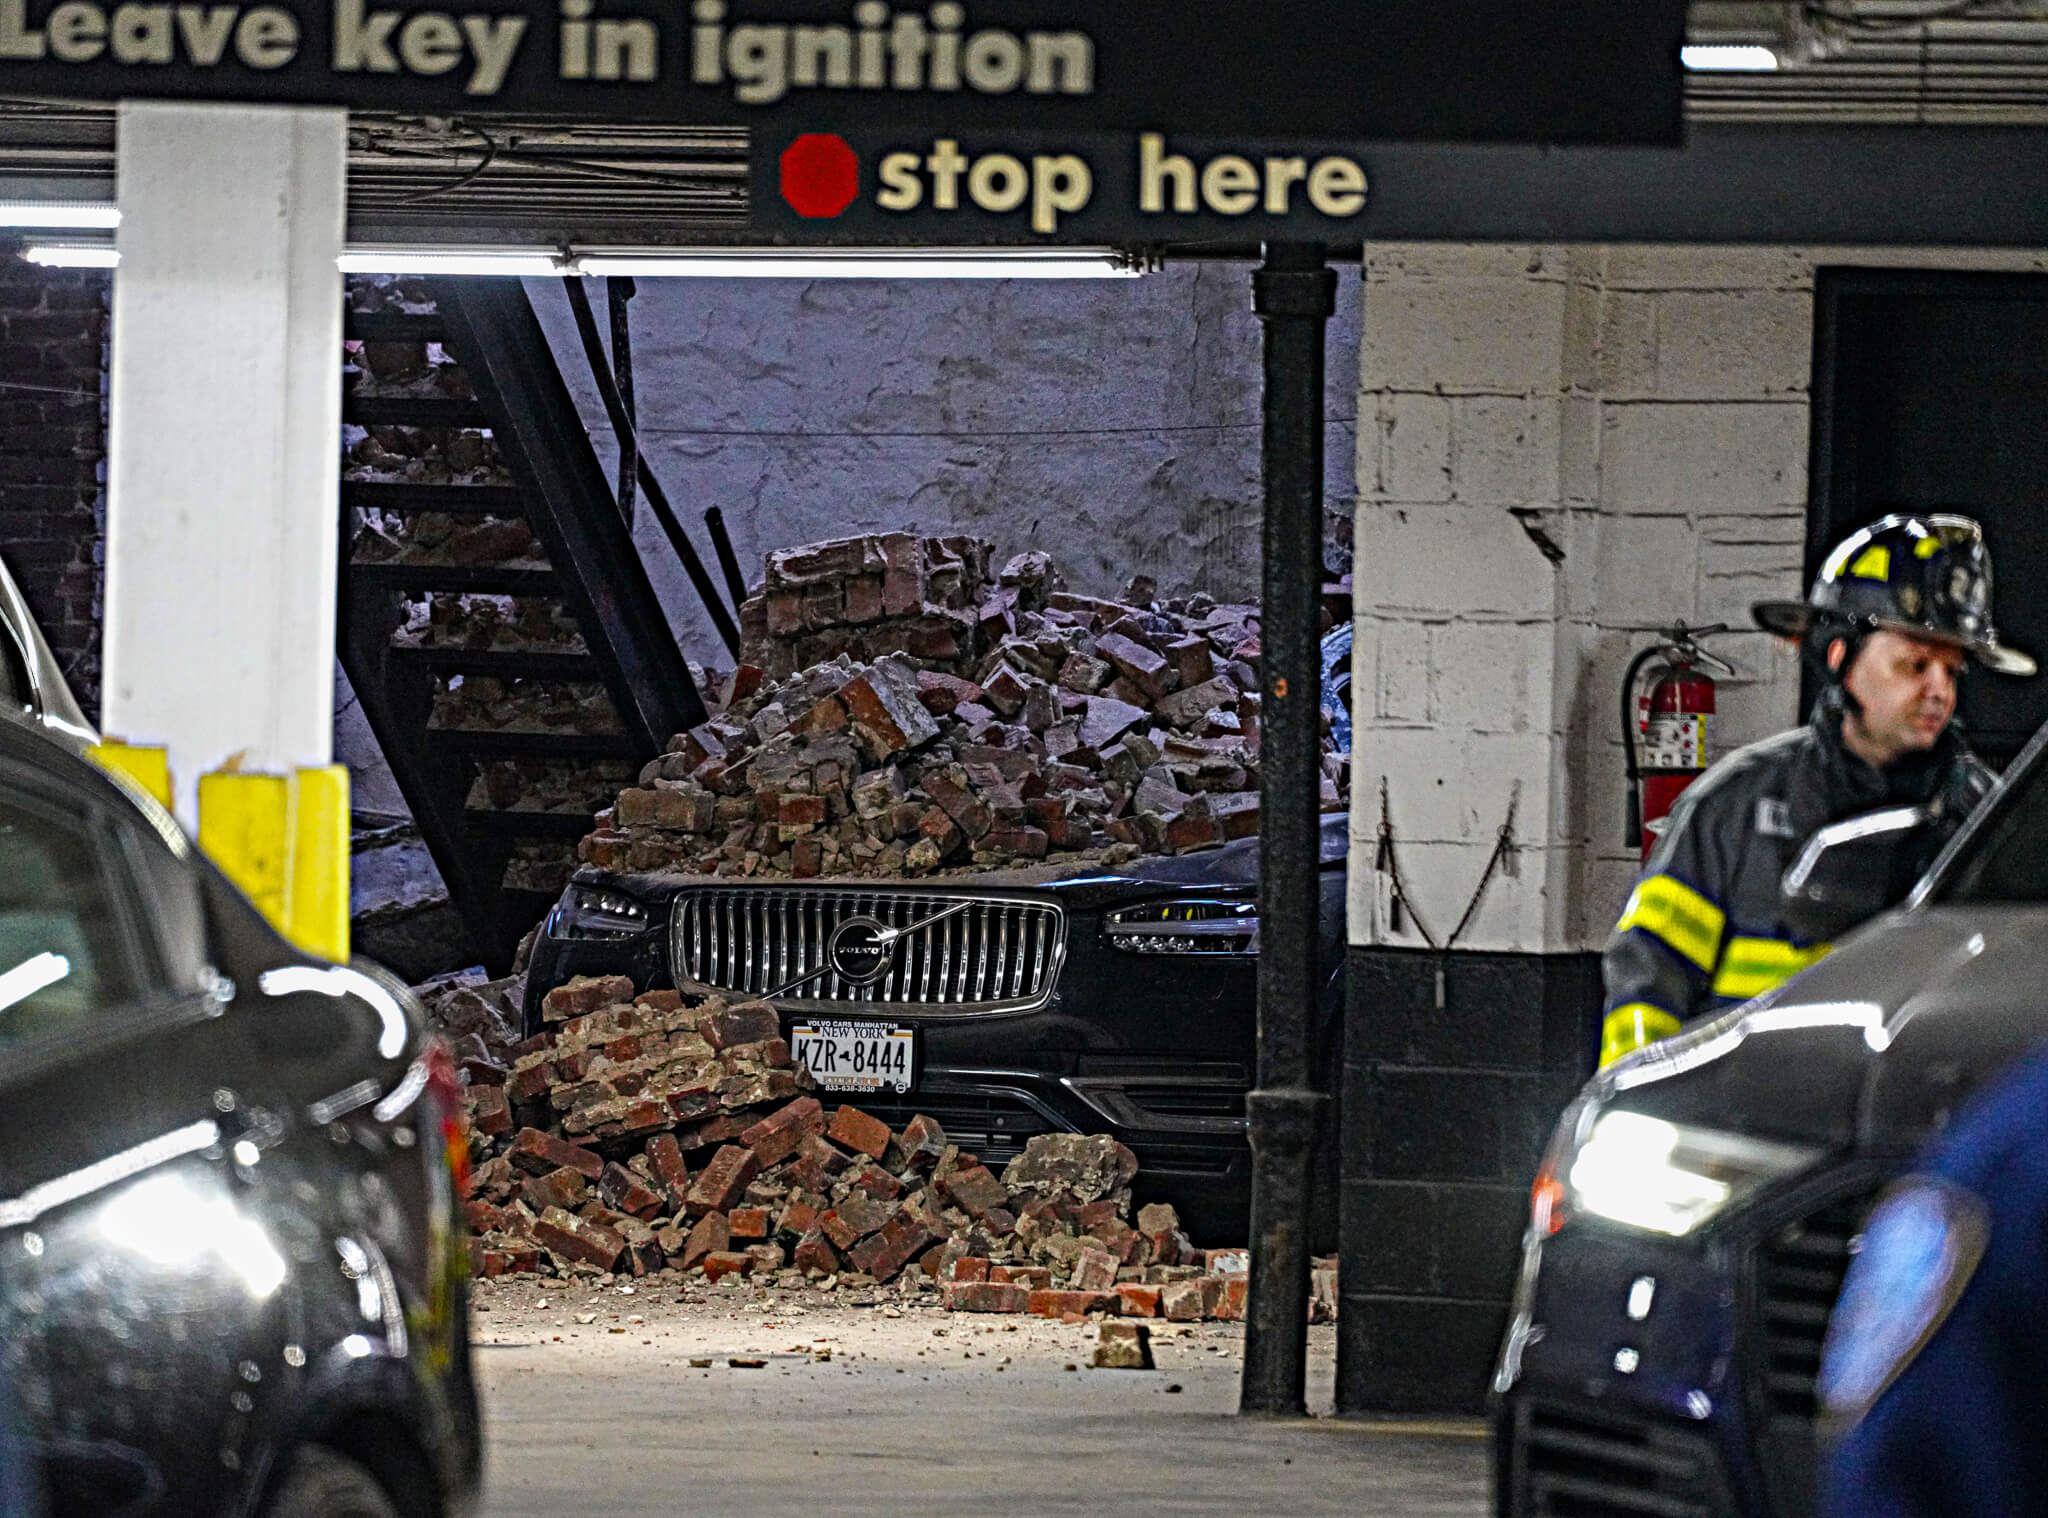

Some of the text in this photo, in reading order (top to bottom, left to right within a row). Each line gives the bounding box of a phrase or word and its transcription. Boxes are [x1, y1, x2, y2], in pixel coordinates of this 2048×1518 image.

[0, 0, 1095, 101] Leave key in ignition
[876, 132, 1369, 234] stop here
[838, 946, 882, 955] VOLVO
[853, 1022, 899, 1030] MANHATTAN
[821, 1027, 885, 1040] NEW YORK
